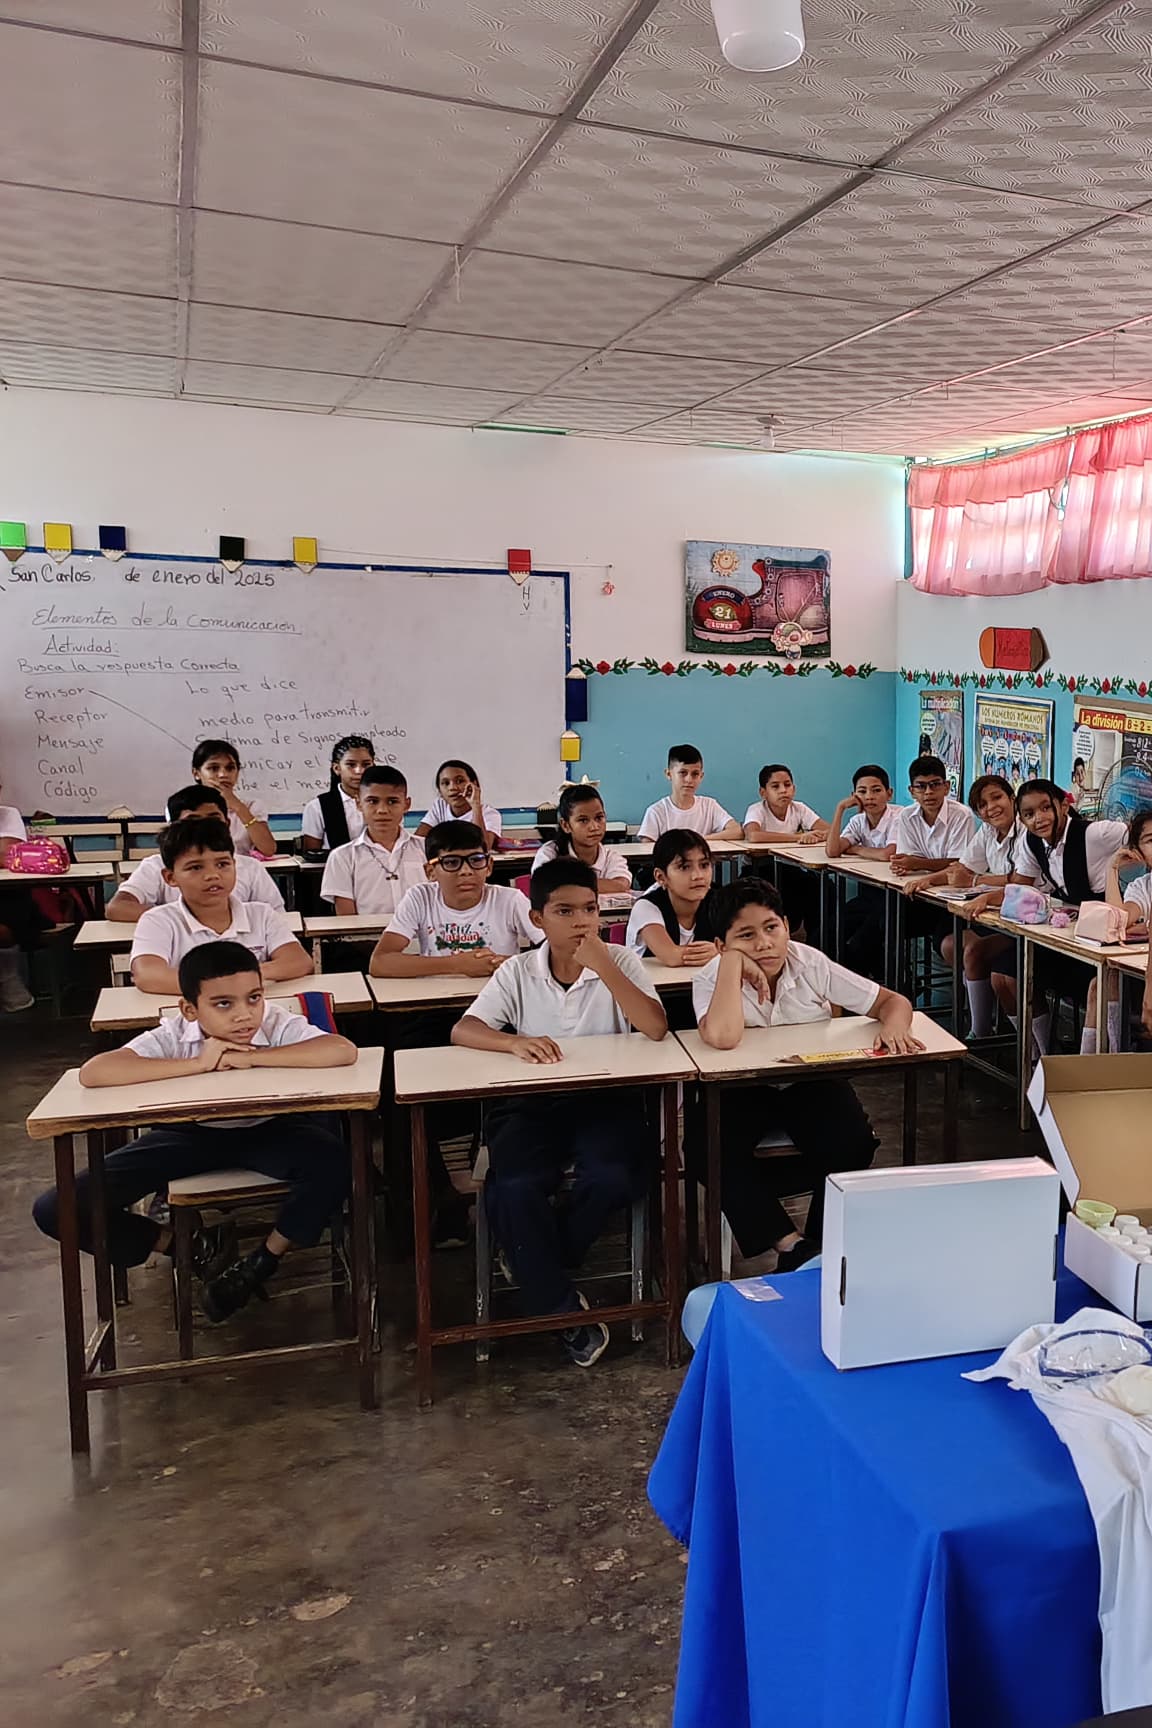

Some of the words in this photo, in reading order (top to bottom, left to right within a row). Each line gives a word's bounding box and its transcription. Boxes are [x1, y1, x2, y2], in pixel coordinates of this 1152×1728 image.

[8, 565, 38, 583] San
[124, 567, 141, 584] de
[152, 570, 202, 585] enero
[206, 567, 225, 585] del
[234, 571, 275, 587] 2025
[32, 604, 117, 626] Elementos
[132, 602, 153, 626] de
[158, 606, 179, 627] la
[715, 606, 732, 619] 21
[18, 659, 65, 673] Busca
[72, 660, 91, 673] la
[97, 656, 174, 676] respuesta
[25, 686, 85, 700] Emisor
[221, 684, 251, 702] que
[261, 676, 299, 691] dice
[34, 707, 109, 729] Receptor
[199, 712, 255, 728] medio
[264, 713, 298, 730] para
[1081, 711, 1092, 725] La
[1092, 713, 1124, 731] división
[37, 735, 104, 754] Mensaje
[272, 729, 293, 744] de
[38, 756, 84, 776] Canal
[304, 754, 321, 769] el
[43, 780, 98, 804] Código
